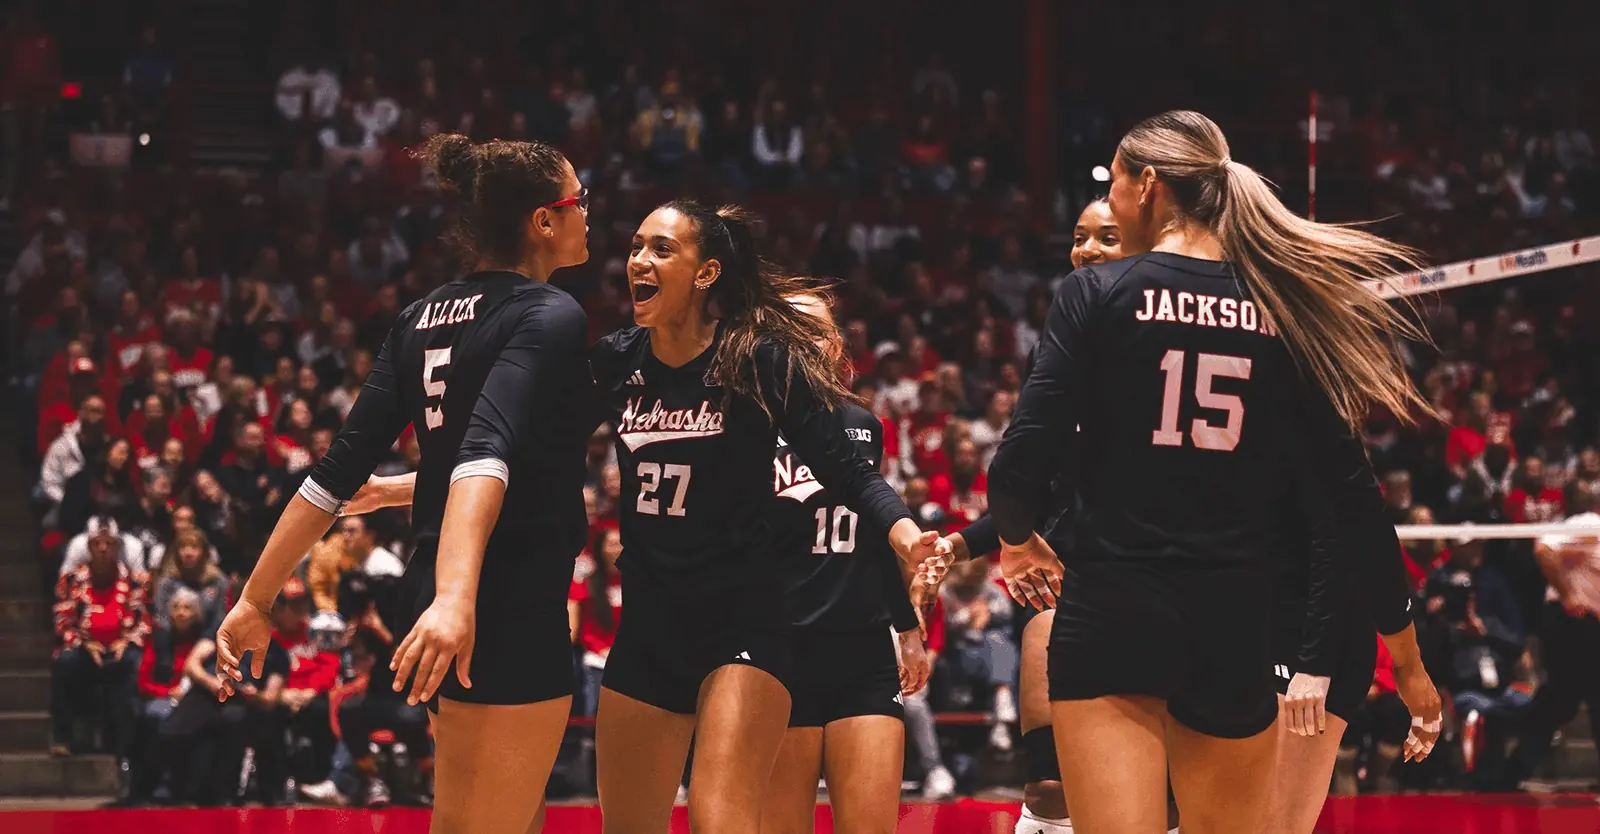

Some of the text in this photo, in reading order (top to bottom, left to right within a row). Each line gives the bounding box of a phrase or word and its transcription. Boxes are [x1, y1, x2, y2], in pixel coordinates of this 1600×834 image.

[414, 293, 484, 331] ALLICK
[422, 346, 452, 432] 5
[616, 396, 724, 434] Nebraska
[1151, 349, 1252, 452] 15
[636, 461, 692, 517] 27
[811, 505, 859, 555] 10
